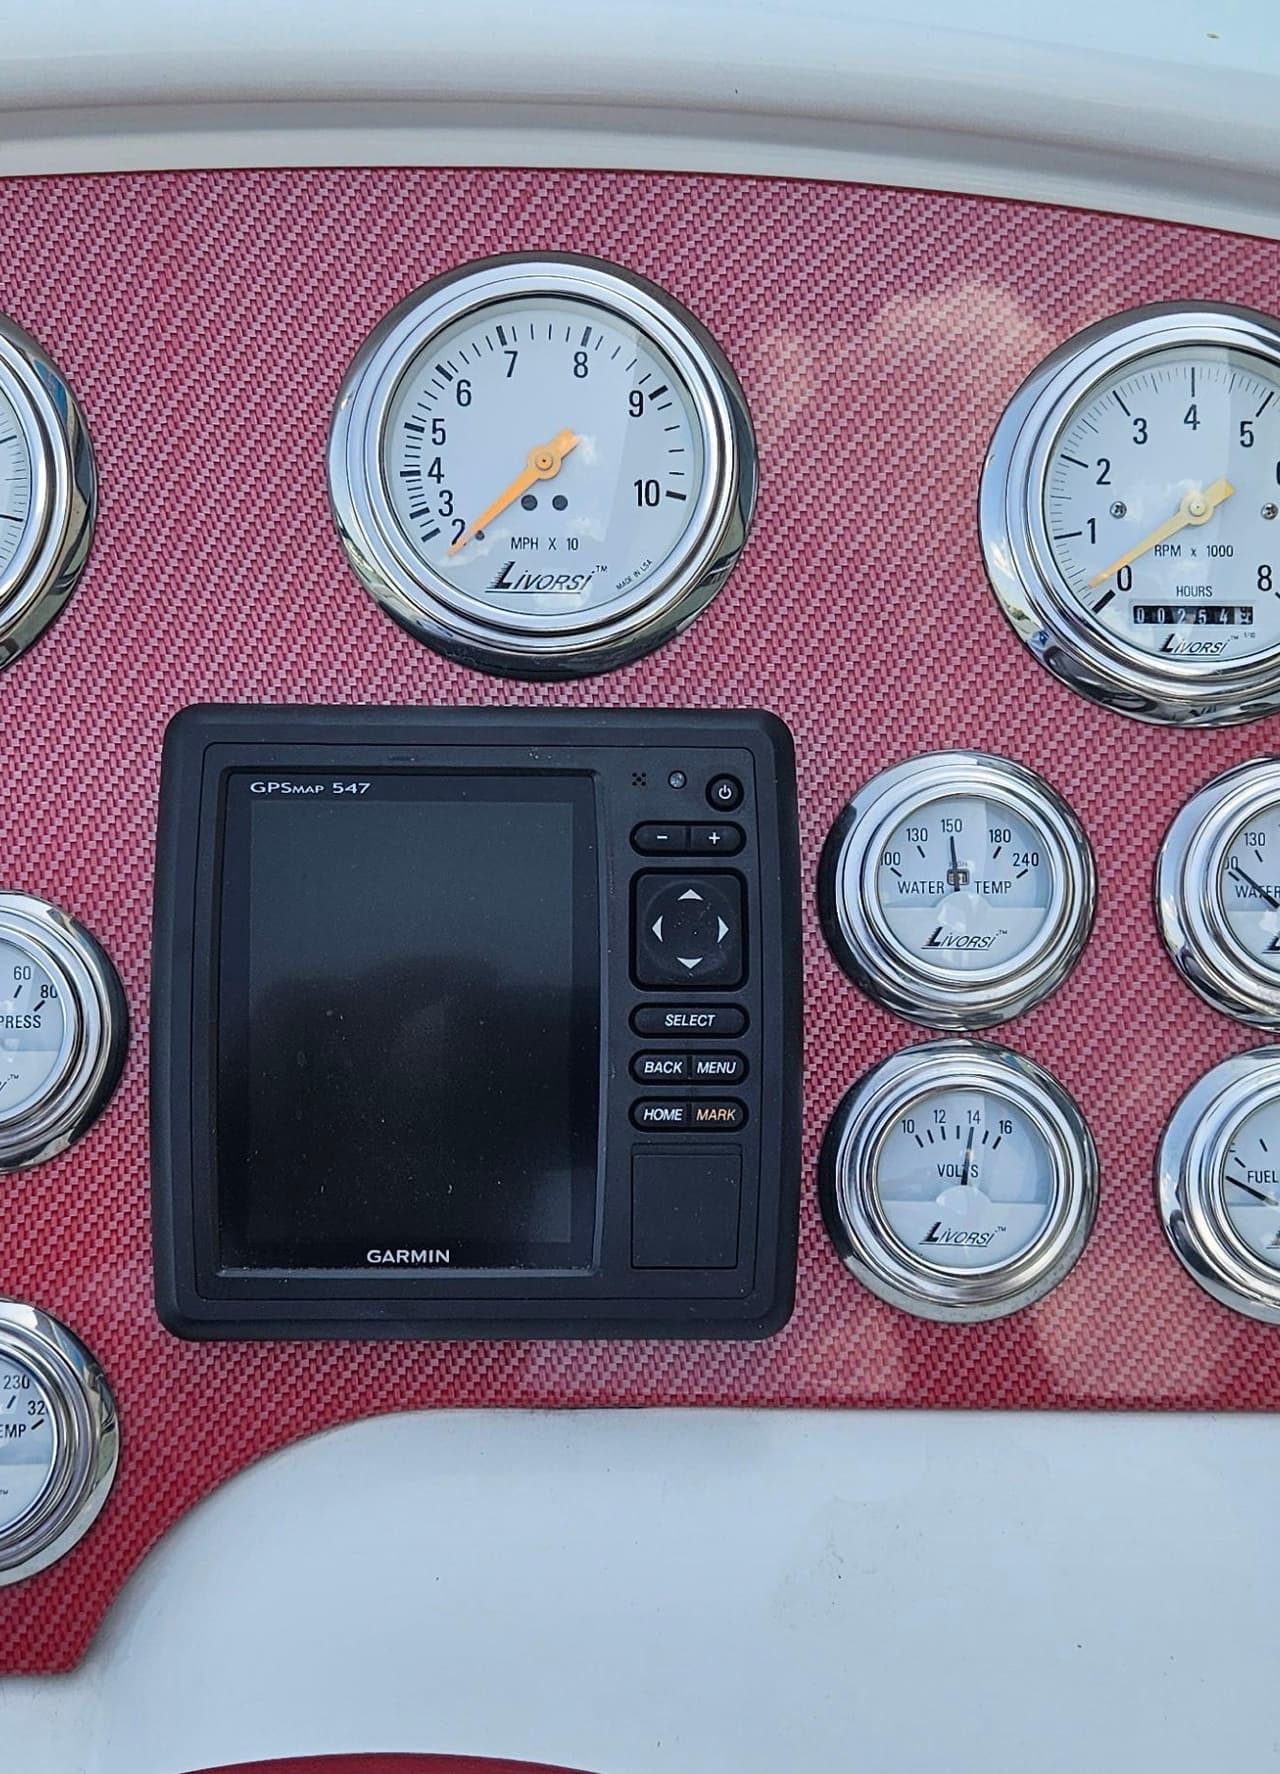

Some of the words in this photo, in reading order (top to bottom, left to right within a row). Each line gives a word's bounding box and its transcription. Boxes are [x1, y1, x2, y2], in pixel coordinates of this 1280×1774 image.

[504, 351, 518, 378] 7
[573, 351, 588, 378] 8
[456, 379, 472, 407] 6
[629, 391, 643, 417] 9
[1184, 404, 1200, 430] 4
[432, 418, 446, 445] 5
[1133, 418, 1148, 444] 3
[1240, 421, 1254, 447] 5
[428, 457, 444, 484] 4
[1096, 459, 1111, 485] 2
[634, 479, 660, 506] 10
[438, 490, 453, 517] 3
[452, 519, 466, 546] 2
[1087, 518, 1096, 544] 1
[511, 537, 538, 550] MPH
[567, 537, 579, 551] 10
[1154, 544, 1181, 557] RPM
[1206, 545, 1233, 557] 1000
[1117, 565, 1132, 591] 0
[1257, 565, 1272, 591] 8
[1176, 586, 1213, 597] HOURS
[333, 783, 371, 794] 547
[940, 818, 962, 833] 150
[906, 827, 928, 842] 130
[989, 829, 1011, 843] 180
[1245, 832, 1265, 846] 130
[1013, 852, 1039, 867] 240
[897, 881, 944, 894] WATER
[974, 881, 1012, 894] TEMP
[13, 966, 31, 980] 60
[40, 984, 58, 999] 80
[664, 1014, 716, 1027] SELECT
[644, 1061, 683, 1074] BACK
[696, 1061, 736, 1074] MENU
[643, 1109, 683, 1121] HOME
[696, 1109, 736, 1121] MARK
[933, 1109, 946, 1124] 12
[967, 1110, 981, 1124] 14
[902, 1119, 915, 1134] 10
[999, 1120, 1012, 1135] 16
[937, 1164, 978, 1178] VOLS
[1247, 1170, 1278, 1183] FUEL
[366, 1249, 449, 1264] GARMIN
[3, 1375, 30, 1390] 230
[27, 1400, 49, 1416] 32
